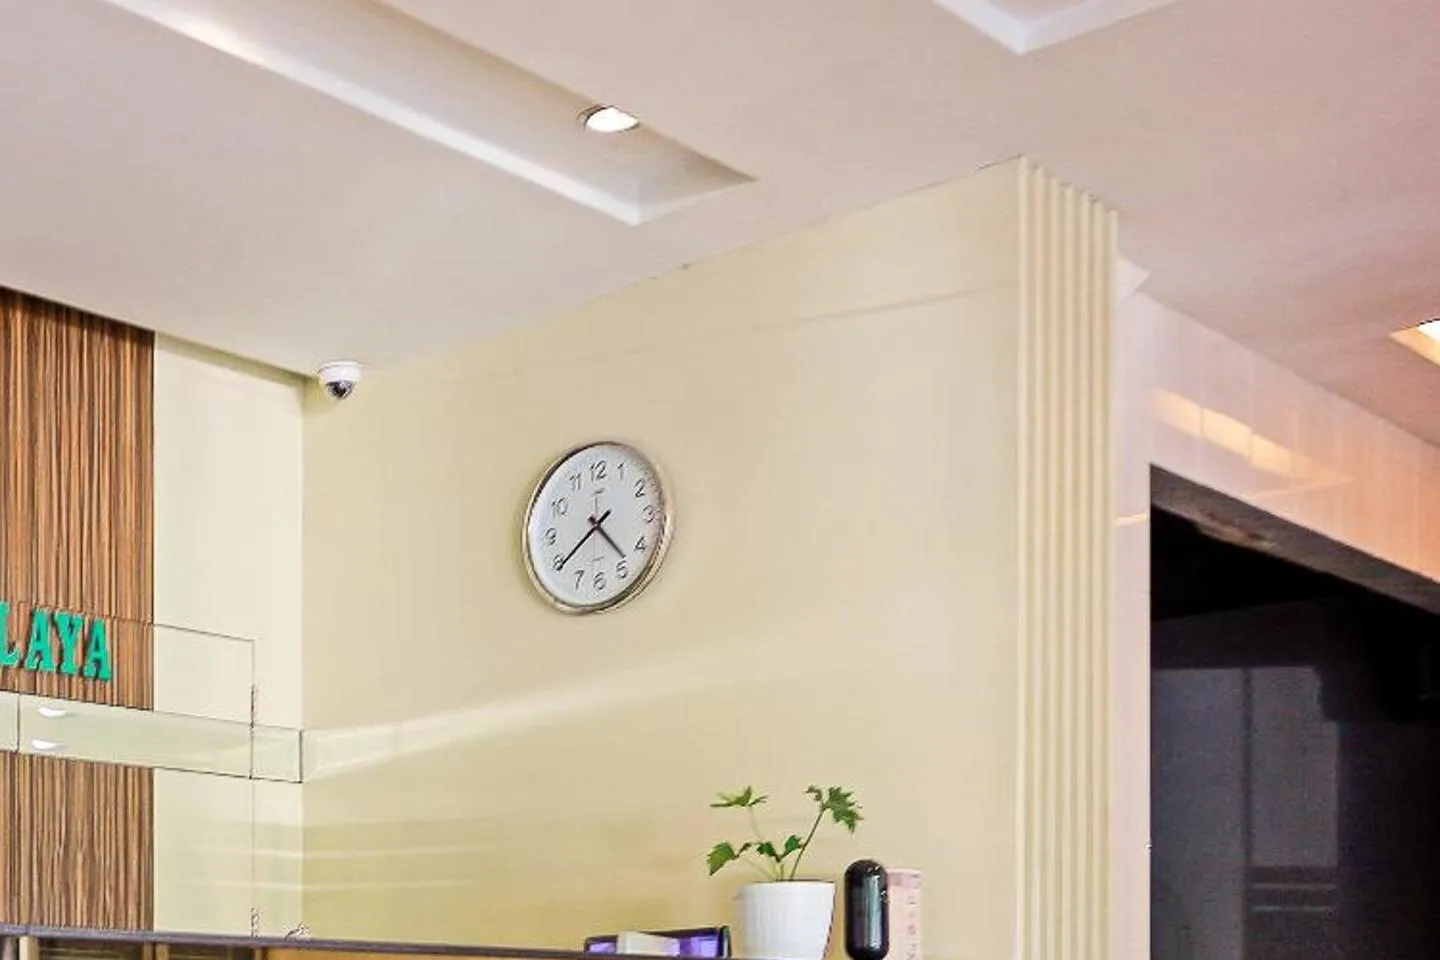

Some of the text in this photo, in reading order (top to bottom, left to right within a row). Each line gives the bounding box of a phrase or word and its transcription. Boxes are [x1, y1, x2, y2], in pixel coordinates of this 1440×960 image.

[590, 460, 607, 482] 12
[617, 462, 626, 481] 1
[570, 473, 582, 491] 11
[634, 479, 646, 498] 2
[551, 497, 568, 518] 10
[643, 504, 655, 524] 3
[545, 527, 558, 546] 9
[634, 535, 647, 553] 4
[616, 560, 629, 579] 5
[575, 570, 585, 591] 7
[593, 571, 607, 590] 6
